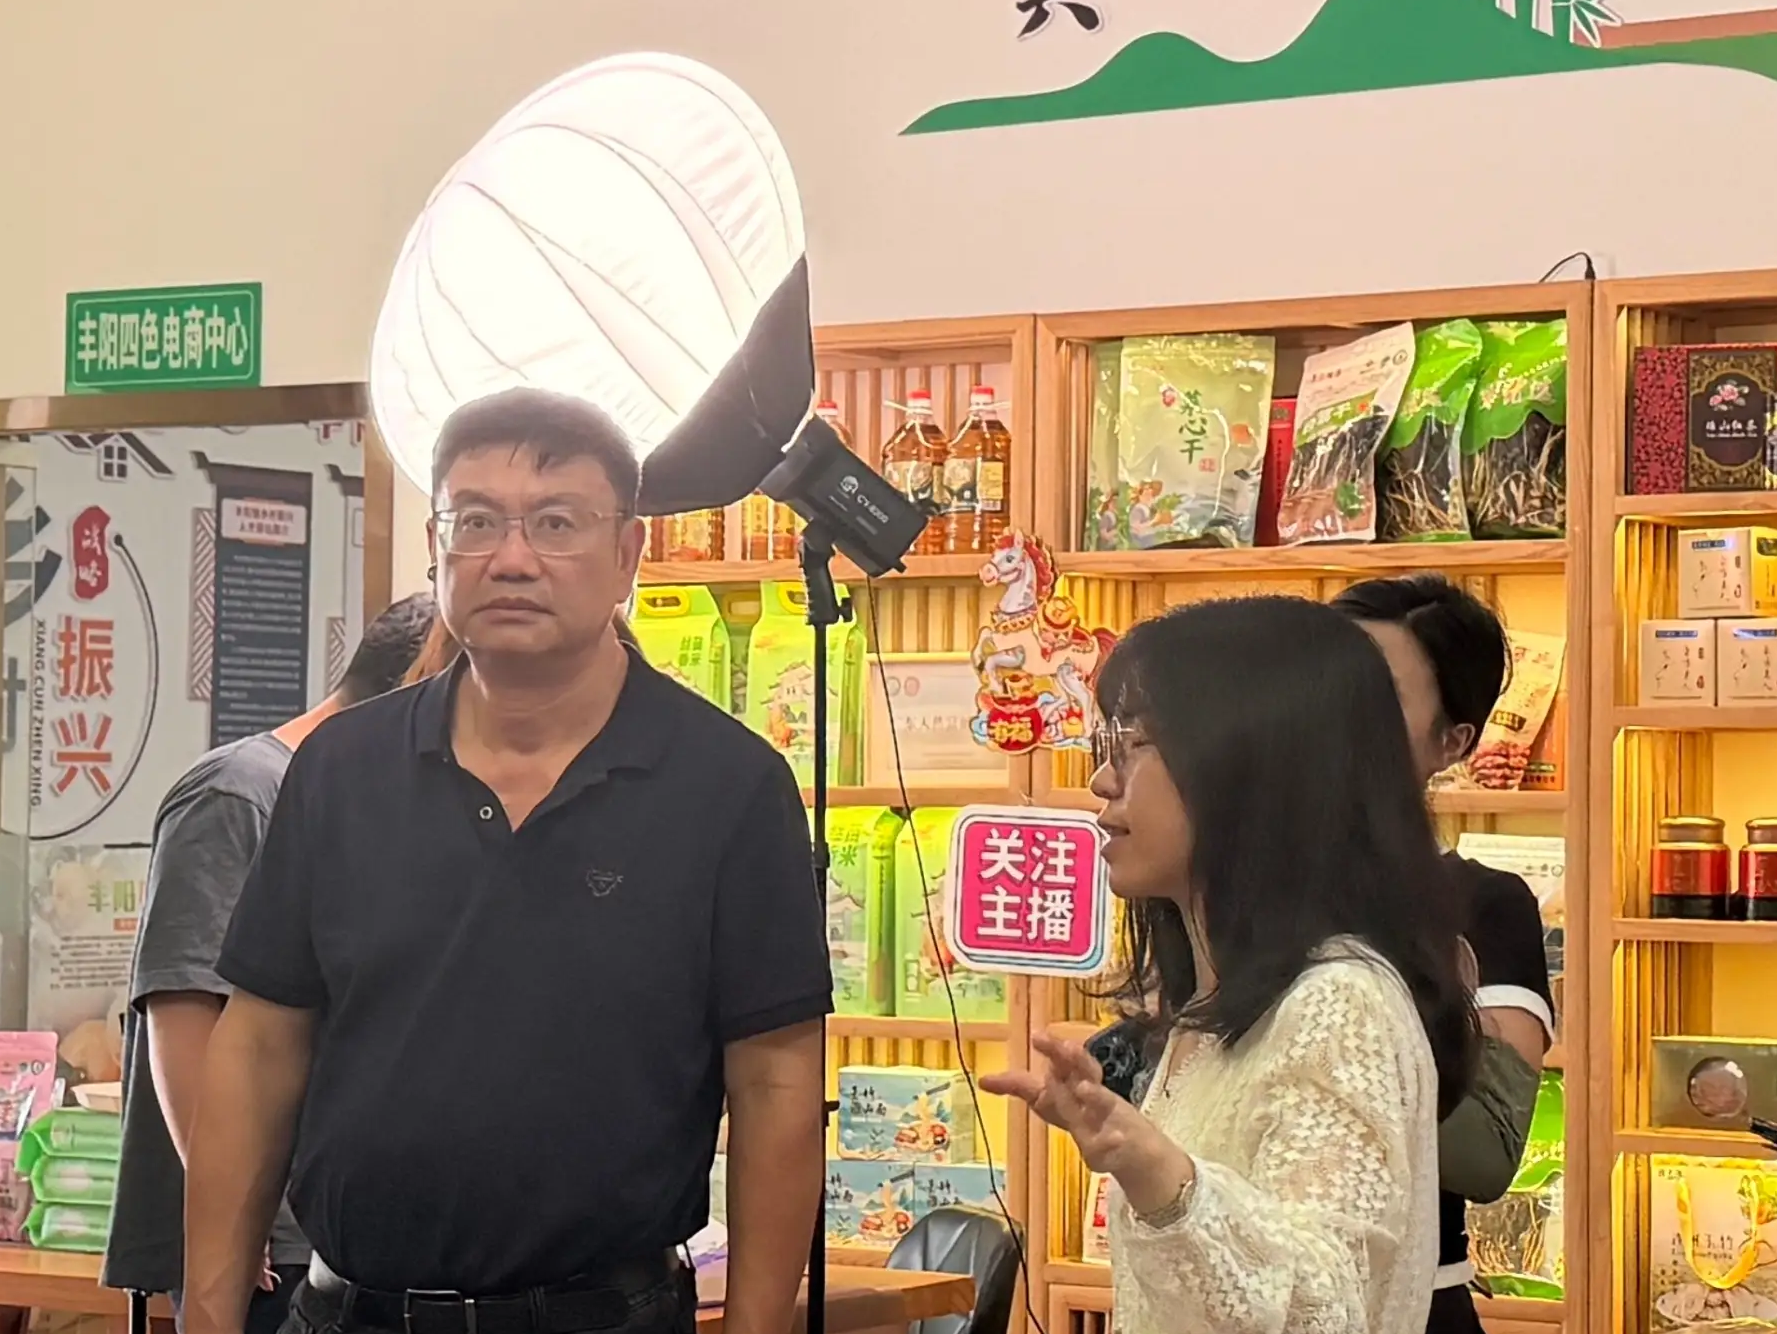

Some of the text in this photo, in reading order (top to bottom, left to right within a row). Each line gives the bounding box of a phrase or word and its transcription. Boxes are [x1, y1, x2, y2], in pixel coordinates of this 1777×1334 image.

[77, 303, 249, 375] 丰阳四色电商中心
[30, 619, 46, 807] XIANG CUN ZHEN XING
[54, 614, 115, 796] 振兴
[979, 829, 1078, 885] 关注
[977, 884, 1075, 944] 主播
